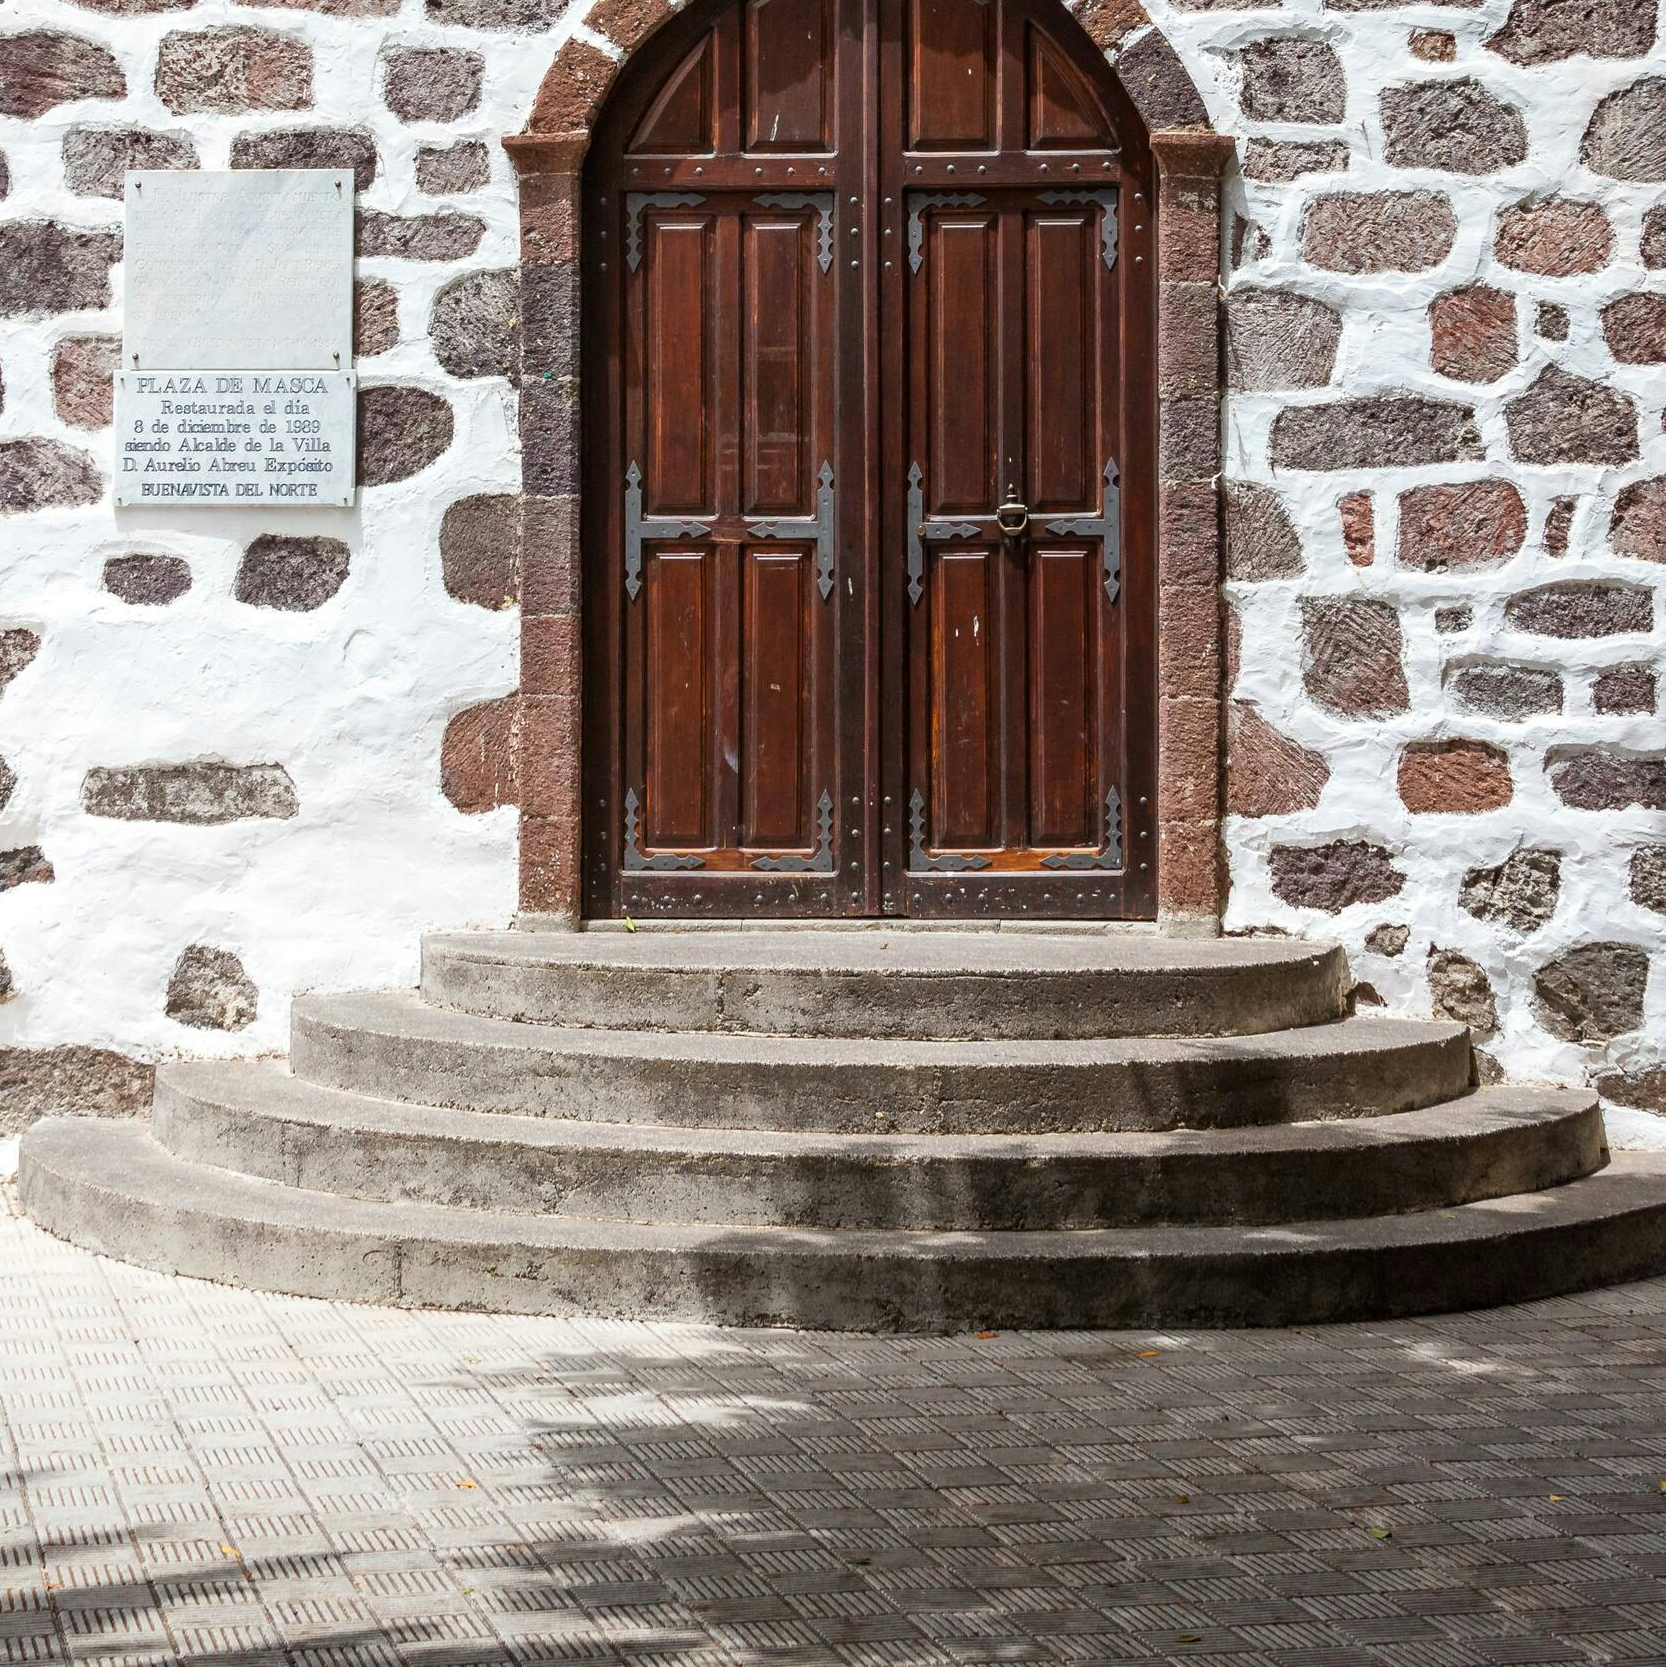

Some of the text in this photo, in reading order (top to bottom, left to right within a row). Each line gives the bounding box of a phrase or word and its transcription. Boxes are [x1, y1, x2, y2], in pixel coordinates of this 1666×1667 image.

[136, 377, 329, 394] PLAZA DE MASCA
[160, 400, 310, 415] Restaurada el día
[133, 419, 143, 433] 8
[151, 419, 169, 433] de
[177, 419, 251, 433] diciembre
[259, 419, 277, 433] de
[124, 437, 331, 452] siendo Alcalde de la Villa
[122, 455, 333, 476] D. Aurelio Abreu Expósito
[141, 483, 318, 497] BUENAVISTA DEL NORTE
